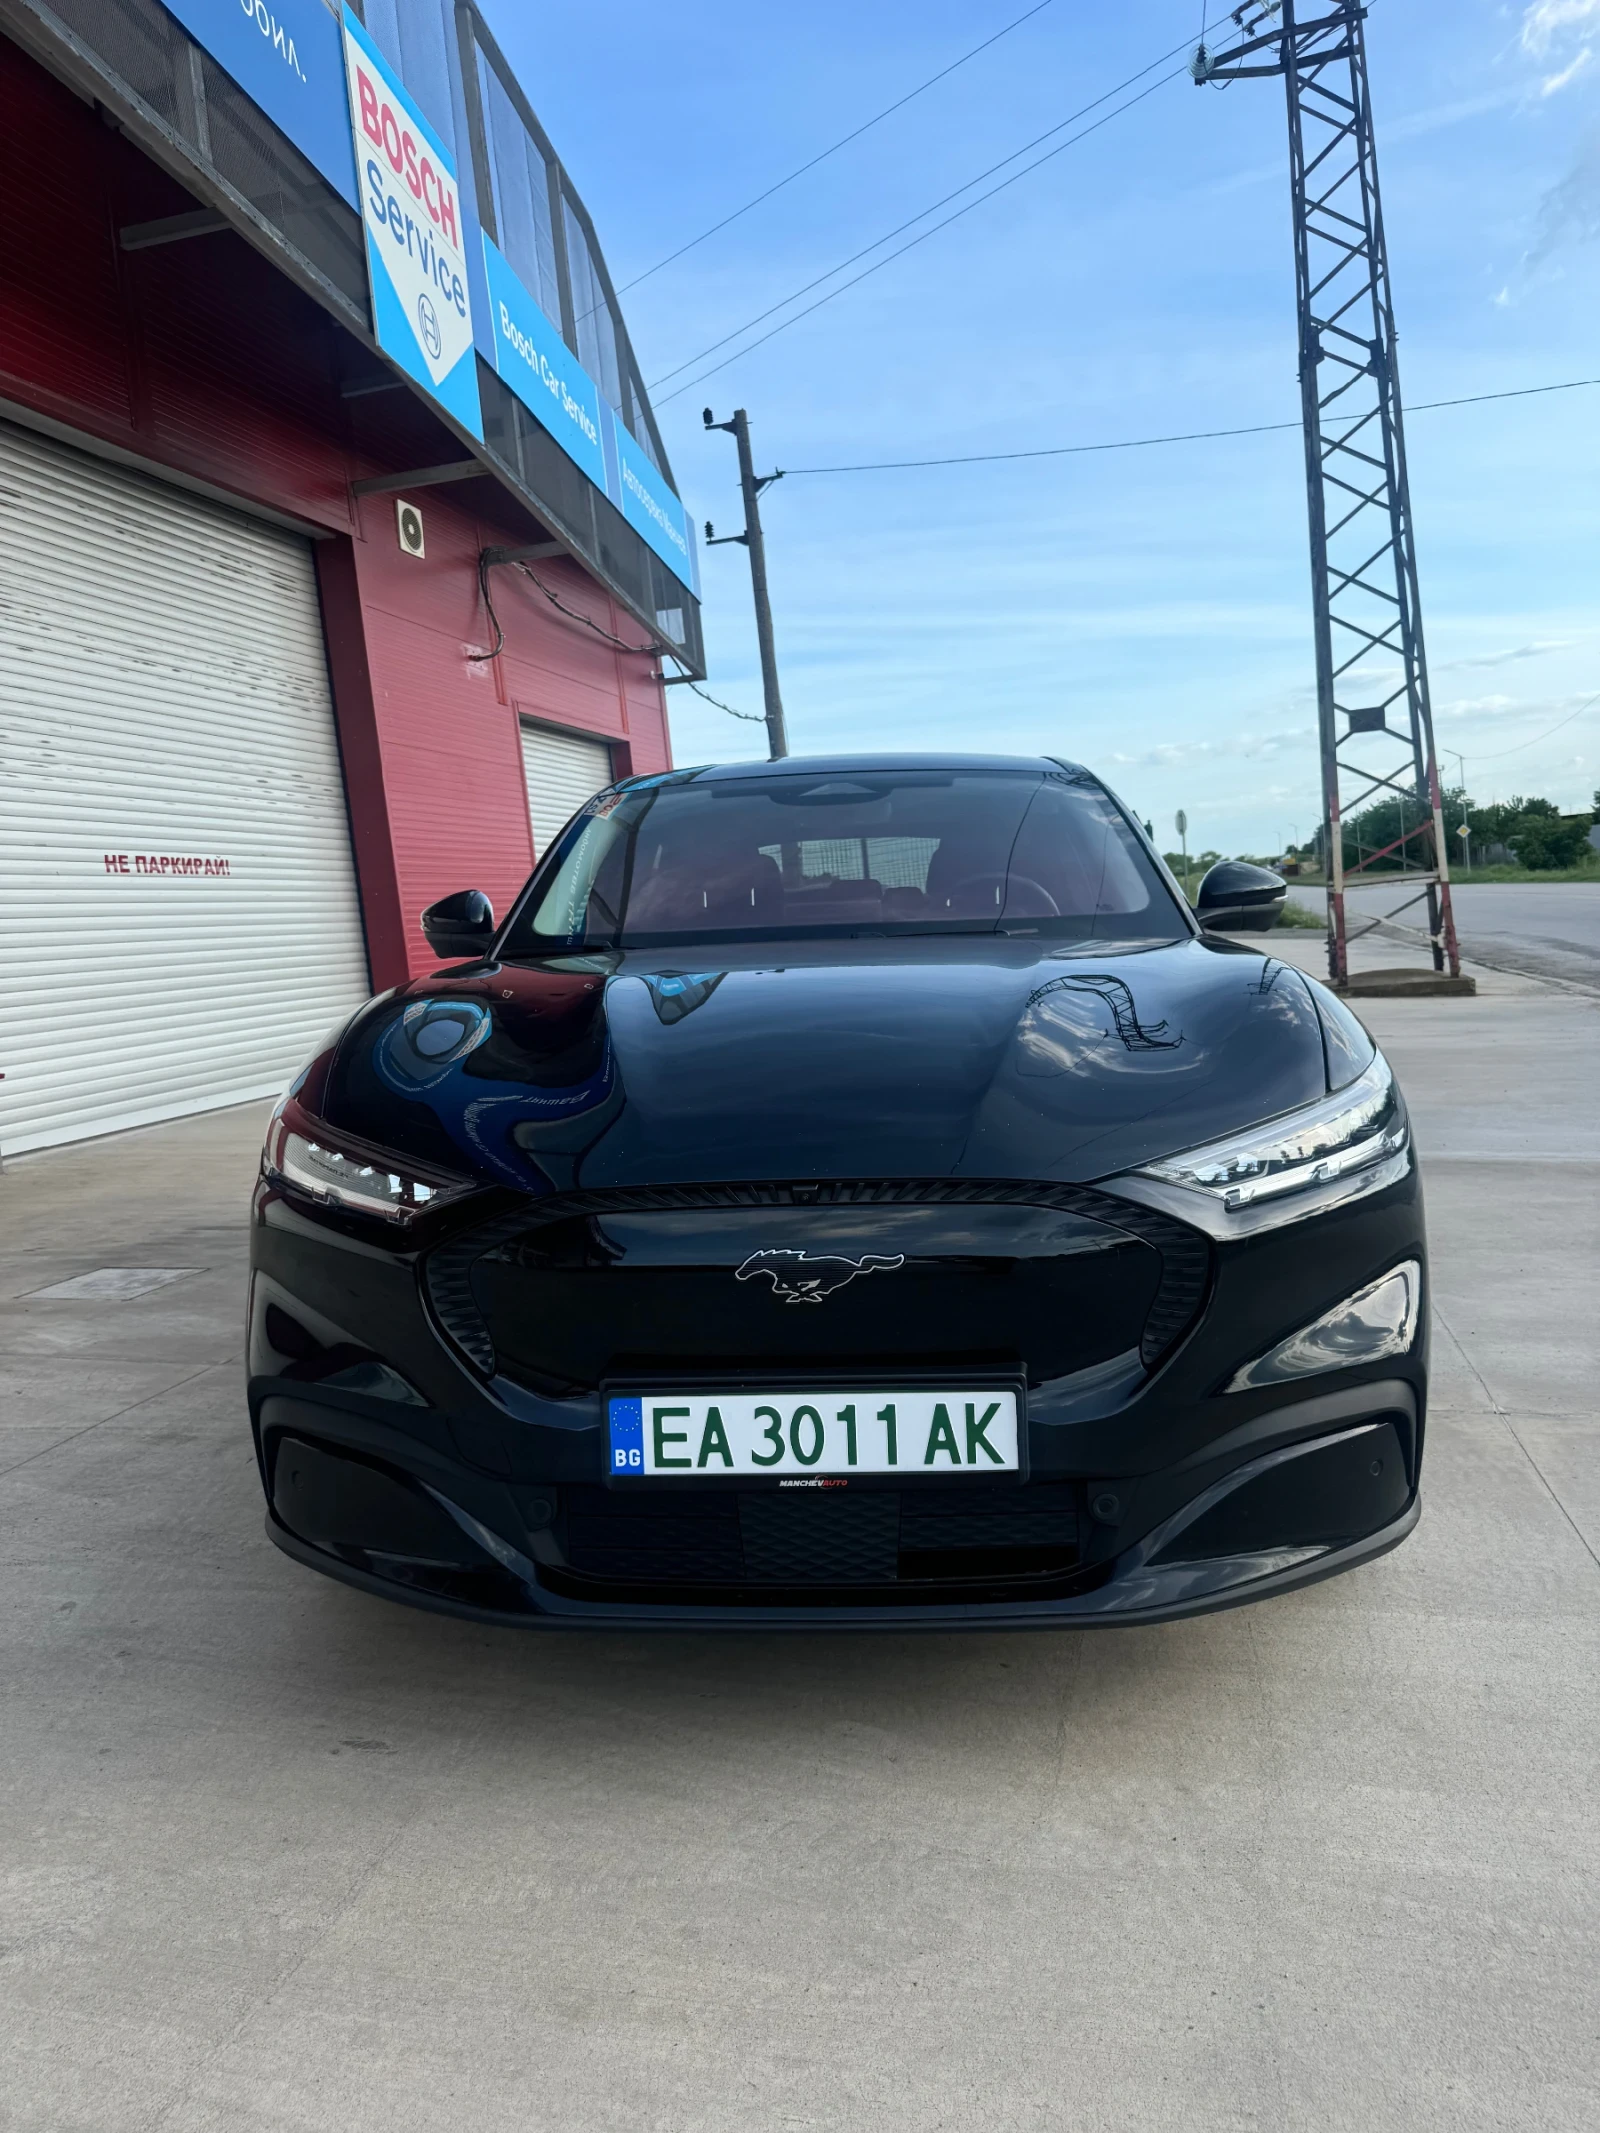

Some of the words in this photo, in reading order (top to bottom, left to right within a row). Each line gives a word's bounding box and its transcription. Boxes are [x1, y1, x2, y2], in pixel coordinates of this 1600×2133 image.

[356, 64, 459, 249] BOSCH
[367, 159, 466, 318] Service
[499, 300, 539, 375] Bosch
[540, 357, 560, 399] Car
[561, 381, 597, 445] Service
[104, 855, 130, 873] НЕ
[135, 856, 230, 876] ПАРКИРАЙ!
[615, 1449, 641, 1467] BG
[652, 1406, 734, 1468] EA
[751, 1404, 898, 1466] 3011
[924, 1402, 1006, 1465] AK
